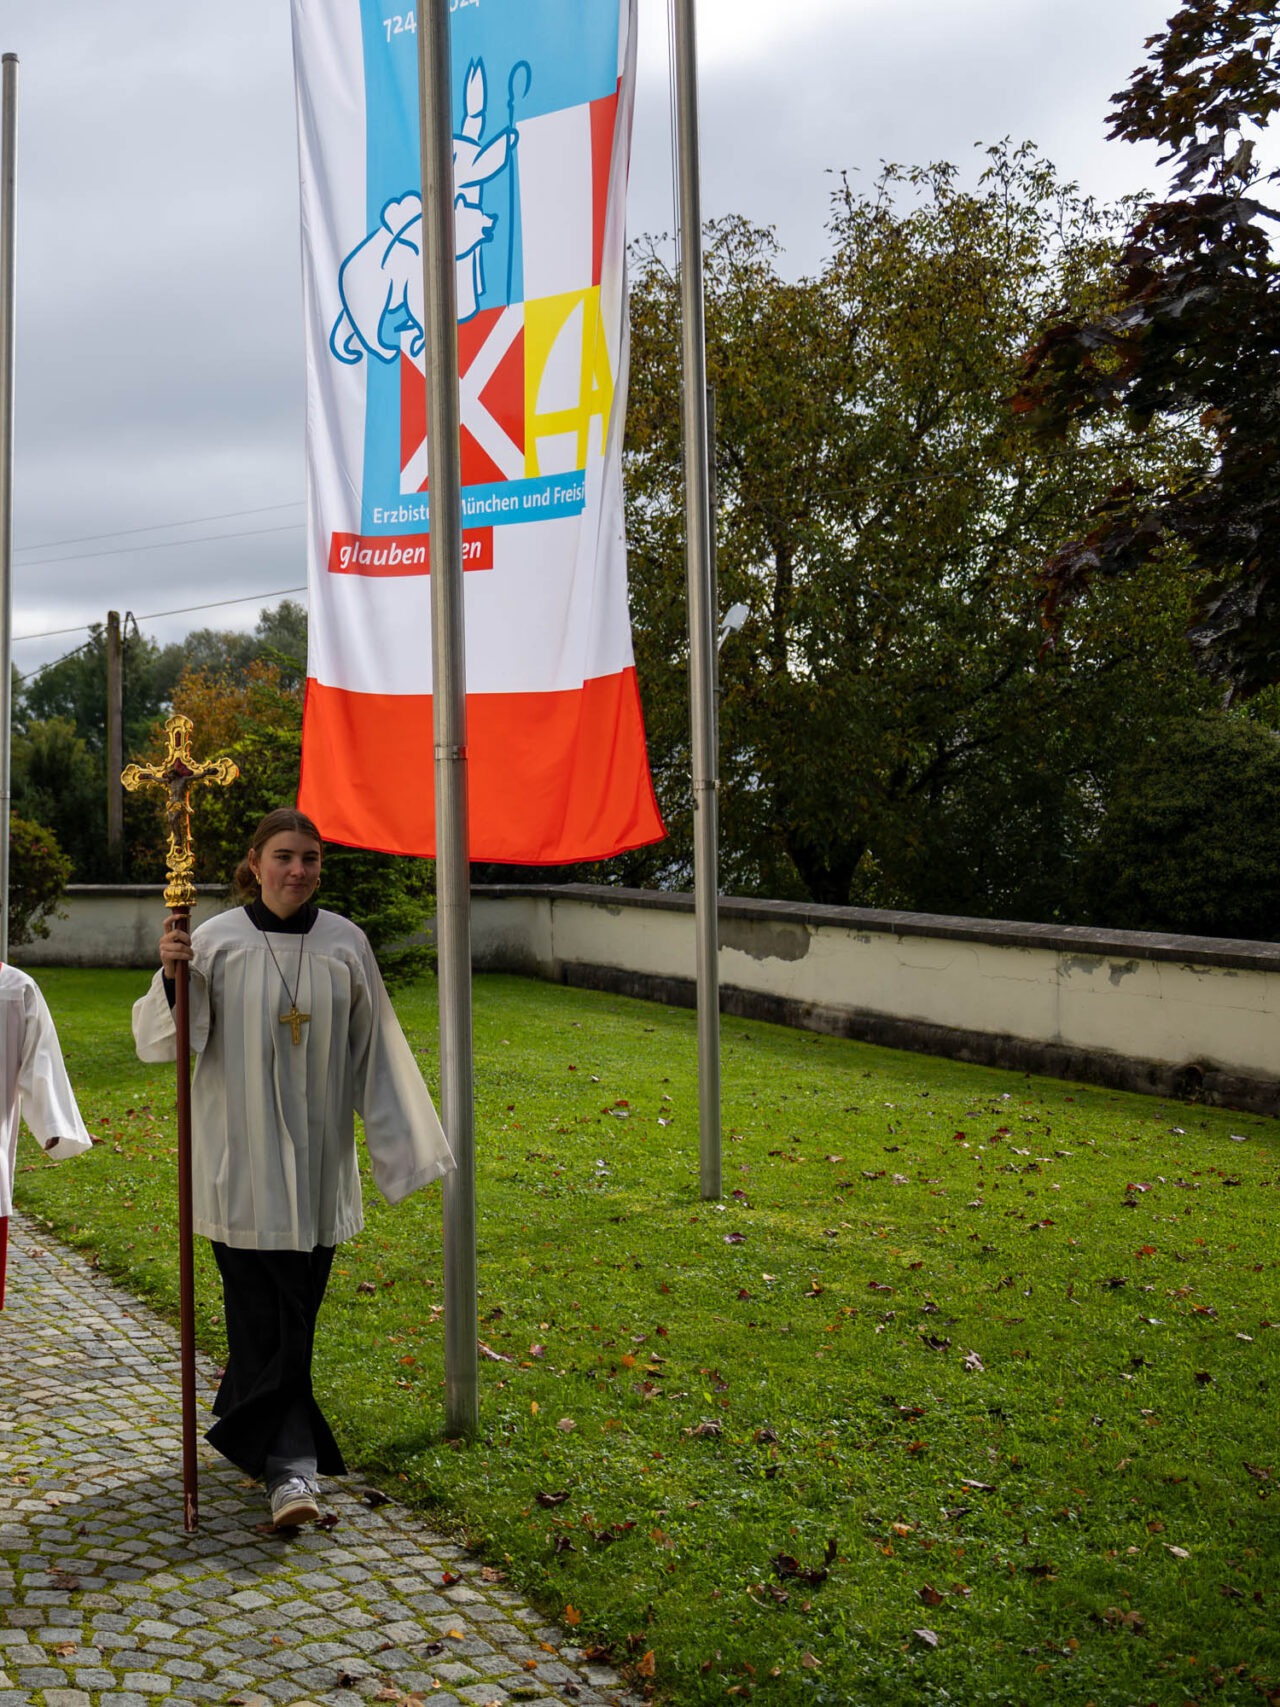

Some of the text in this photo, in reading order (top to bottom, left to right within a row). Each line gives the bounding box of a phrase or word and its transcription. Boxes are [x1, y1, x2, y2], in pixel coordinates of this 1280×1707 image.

[373, 504, 430, 524] Erzbist
[523, 487, 551, 508] und
[554, 481, 586, 505] Freisi
[339, 541, 426, 569] glauben
